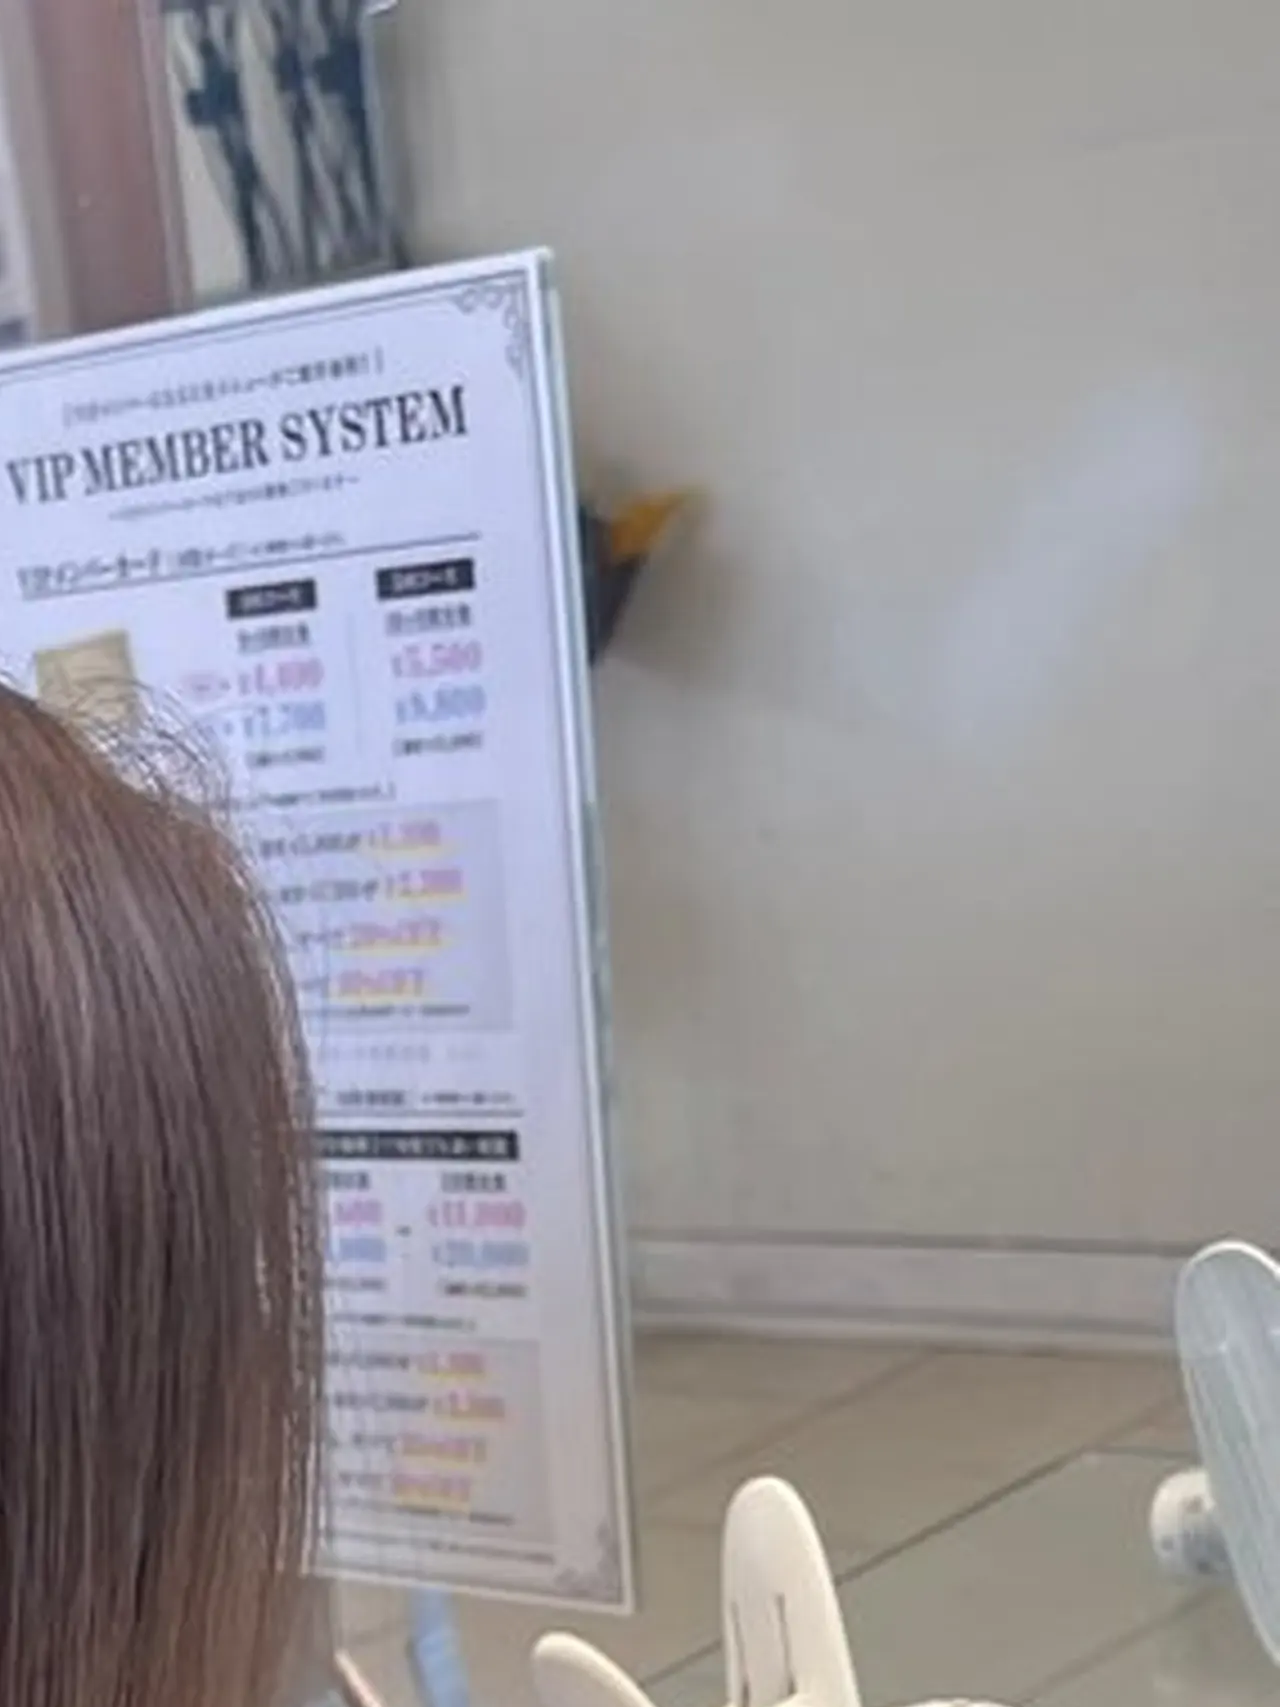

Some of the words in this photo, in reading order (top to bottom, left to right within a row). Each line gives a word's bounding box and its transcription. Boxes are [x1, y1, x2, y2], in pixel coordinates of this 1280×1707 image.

[5, 451, 75, 504] VIP
[80, 416, 271, 496] MEMBER
[279, 384, 468, 462] SYSTEM
